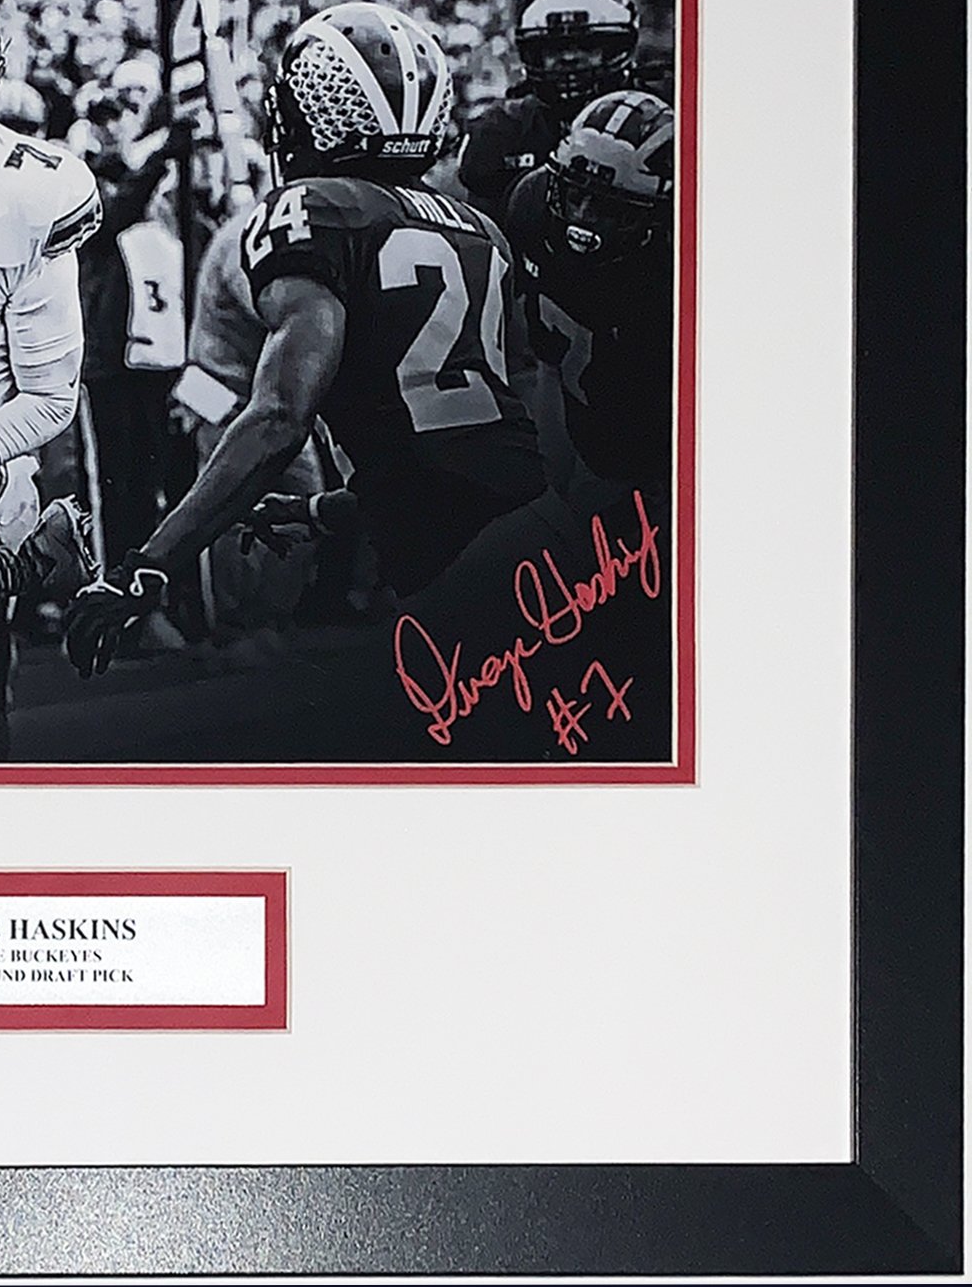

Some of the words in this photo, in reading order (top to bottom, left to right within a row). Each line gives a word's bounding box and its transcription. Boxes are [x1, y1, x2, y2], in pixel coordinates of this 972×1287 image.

[245, 185, 312, 270] 24
[10, 917, 137, 941] HASKINS
[10, 948, 103, 963] BUCKEYES
[31, 969, 86, 983] DRAFT
[93, 969, 134, 983] PICK
